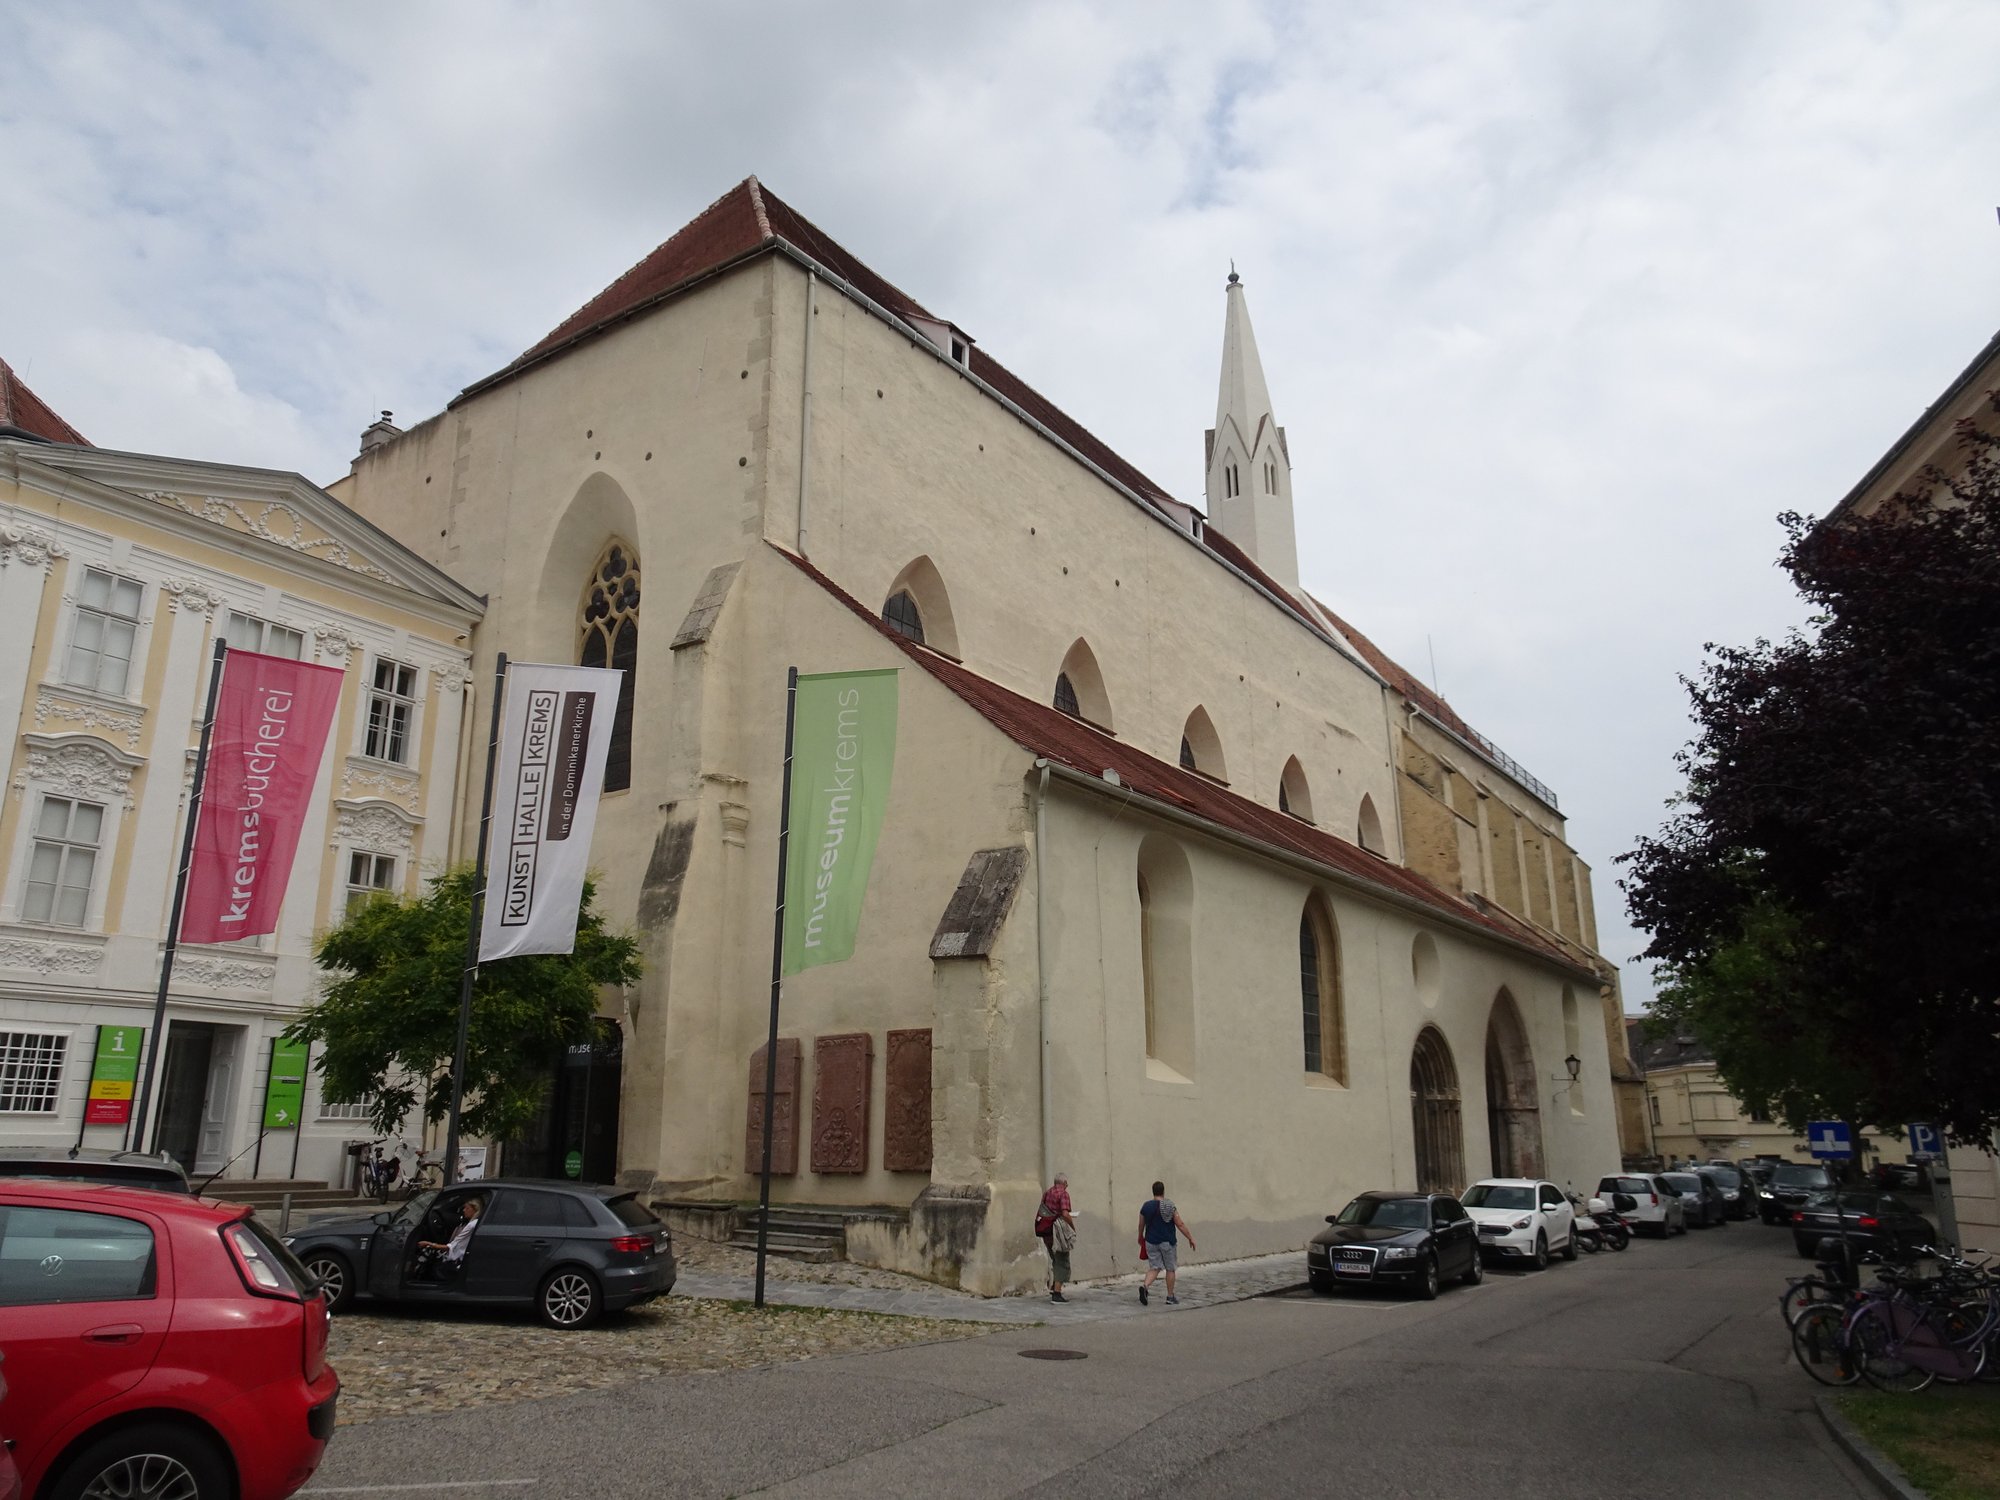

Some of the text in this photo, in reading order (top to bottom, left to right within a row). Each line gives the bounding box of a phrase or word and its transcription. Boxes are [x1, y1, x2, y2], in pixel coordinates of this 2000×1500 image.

[220, 686, 294, 923] kremsbücherei
[508, 697, 552, 918] KUNST HALLE KREMS
[559, 697, 587, 834] in der Dominikanerkirche
[804, 687, 860, 949] museumkrems
[1914, 1125, 1934, 1152] P
